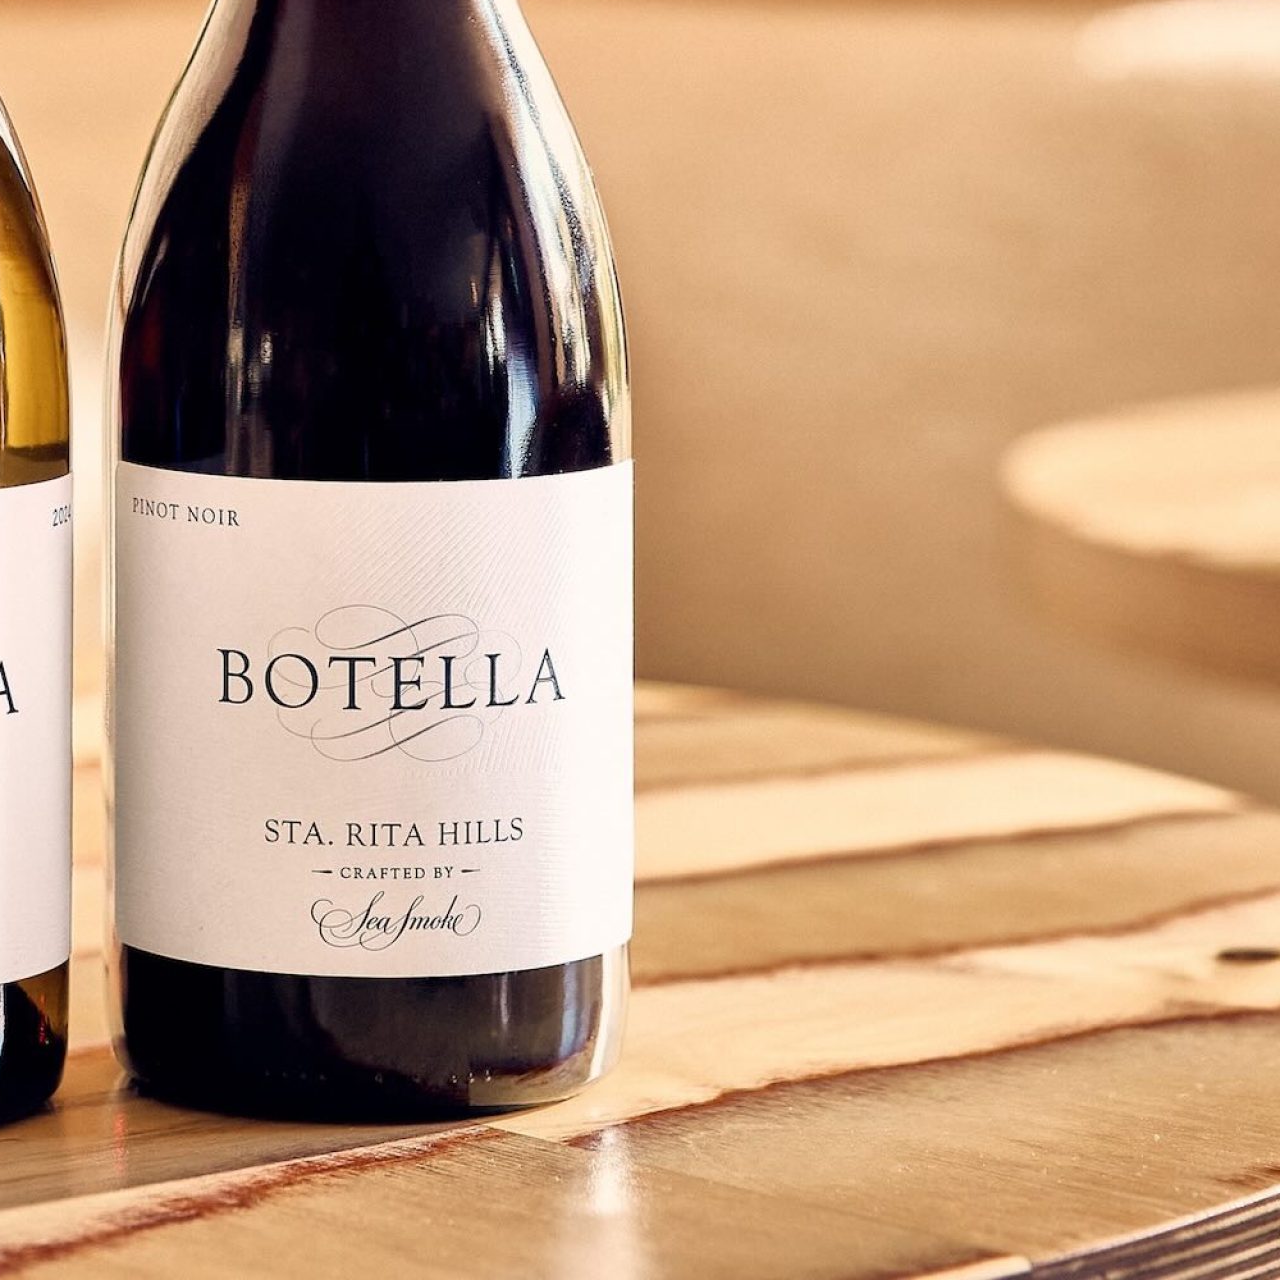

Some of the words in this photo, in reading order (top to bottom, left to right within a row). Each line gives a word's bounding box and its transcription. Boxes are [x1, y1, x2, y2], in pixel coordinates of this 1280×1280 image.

[132, 497, 180, 520] PINOT
[187, 506, 240, 527] NOIR
[216, 647, 566, 711] BOTELLA
[264, 819, 334, 846] STA.
[346, 822, 425, 847] RITA
[438, 817, 524, 845] HILLS
[340, 866, 426, 880] CRAFTED
[433, 865, 454, 879] BY
